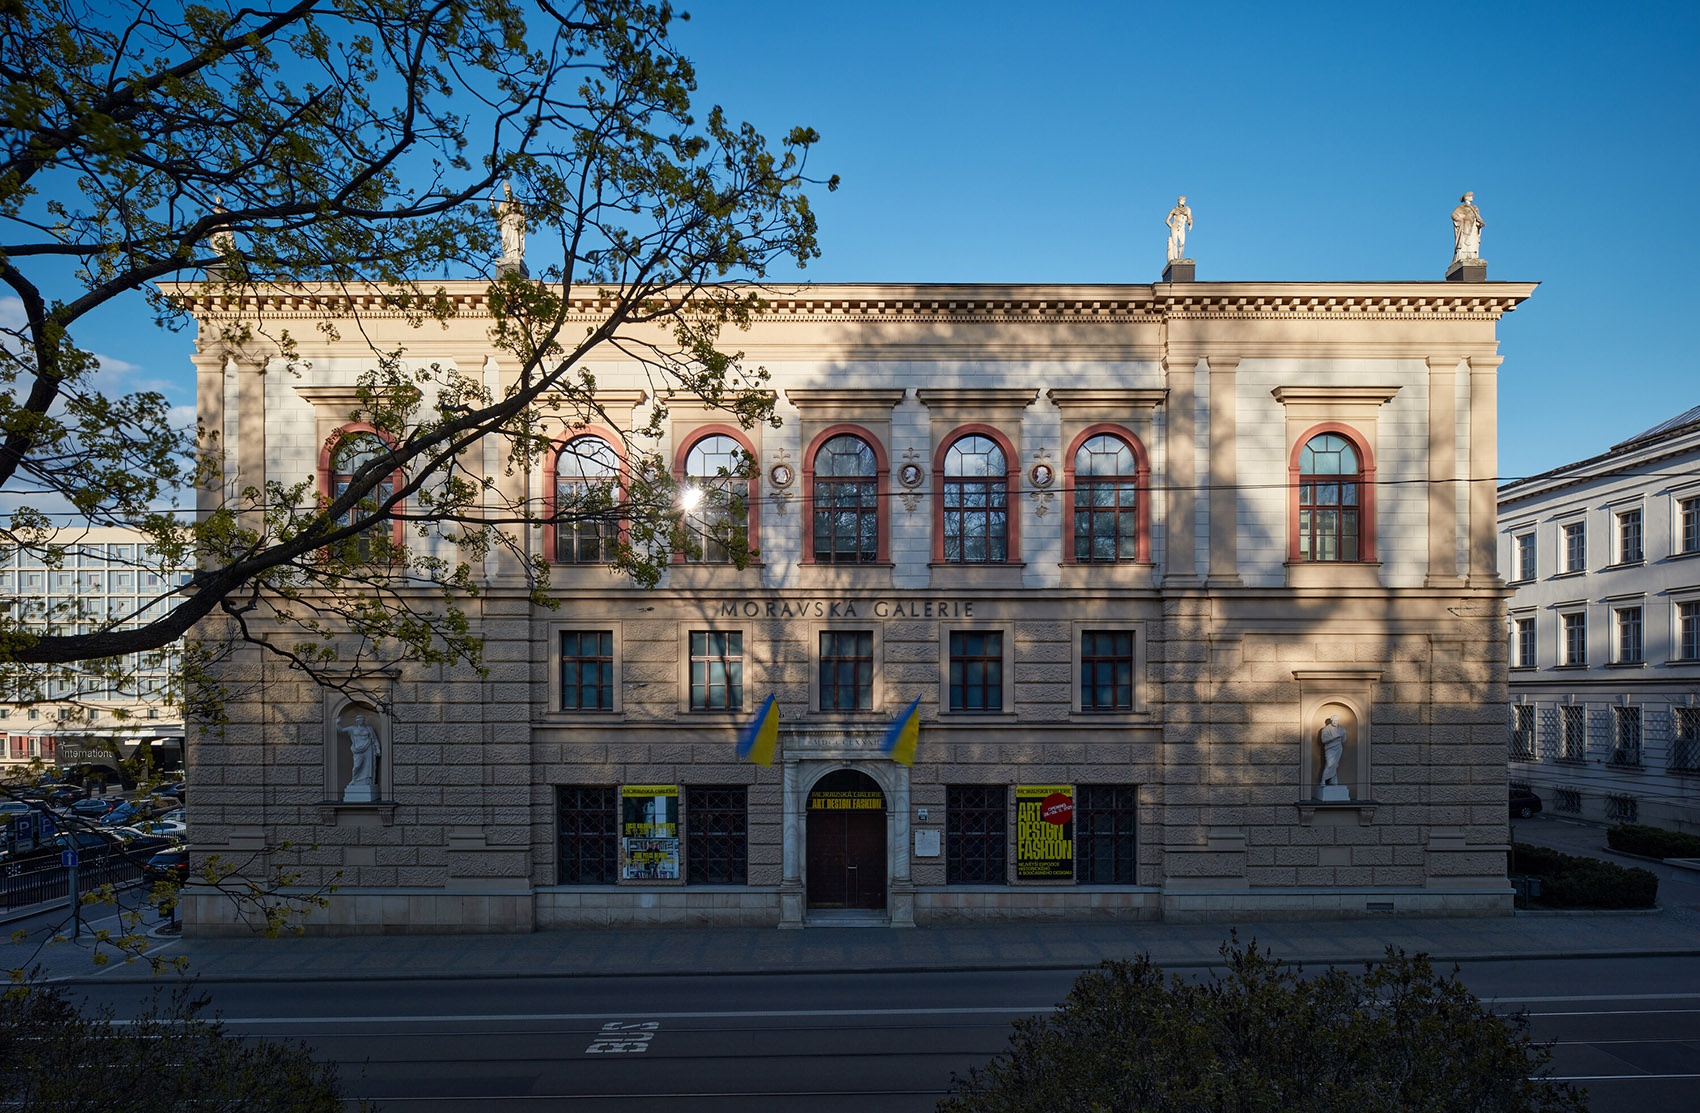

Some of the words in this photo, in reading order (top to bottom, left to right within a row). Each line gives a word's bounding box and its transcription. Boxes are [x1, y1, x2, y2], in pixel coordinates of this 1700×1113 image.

[721, 599, 857, 617] MORAVSKÁ
[874, 601, 974, 617] GALERIE
[1018, 802, 1043, 822] ART
[19, 821, 30, 836] P
[1018, 821, 1064, 841] DESIGN
[1018, 840, 1072, 860] FASHION
